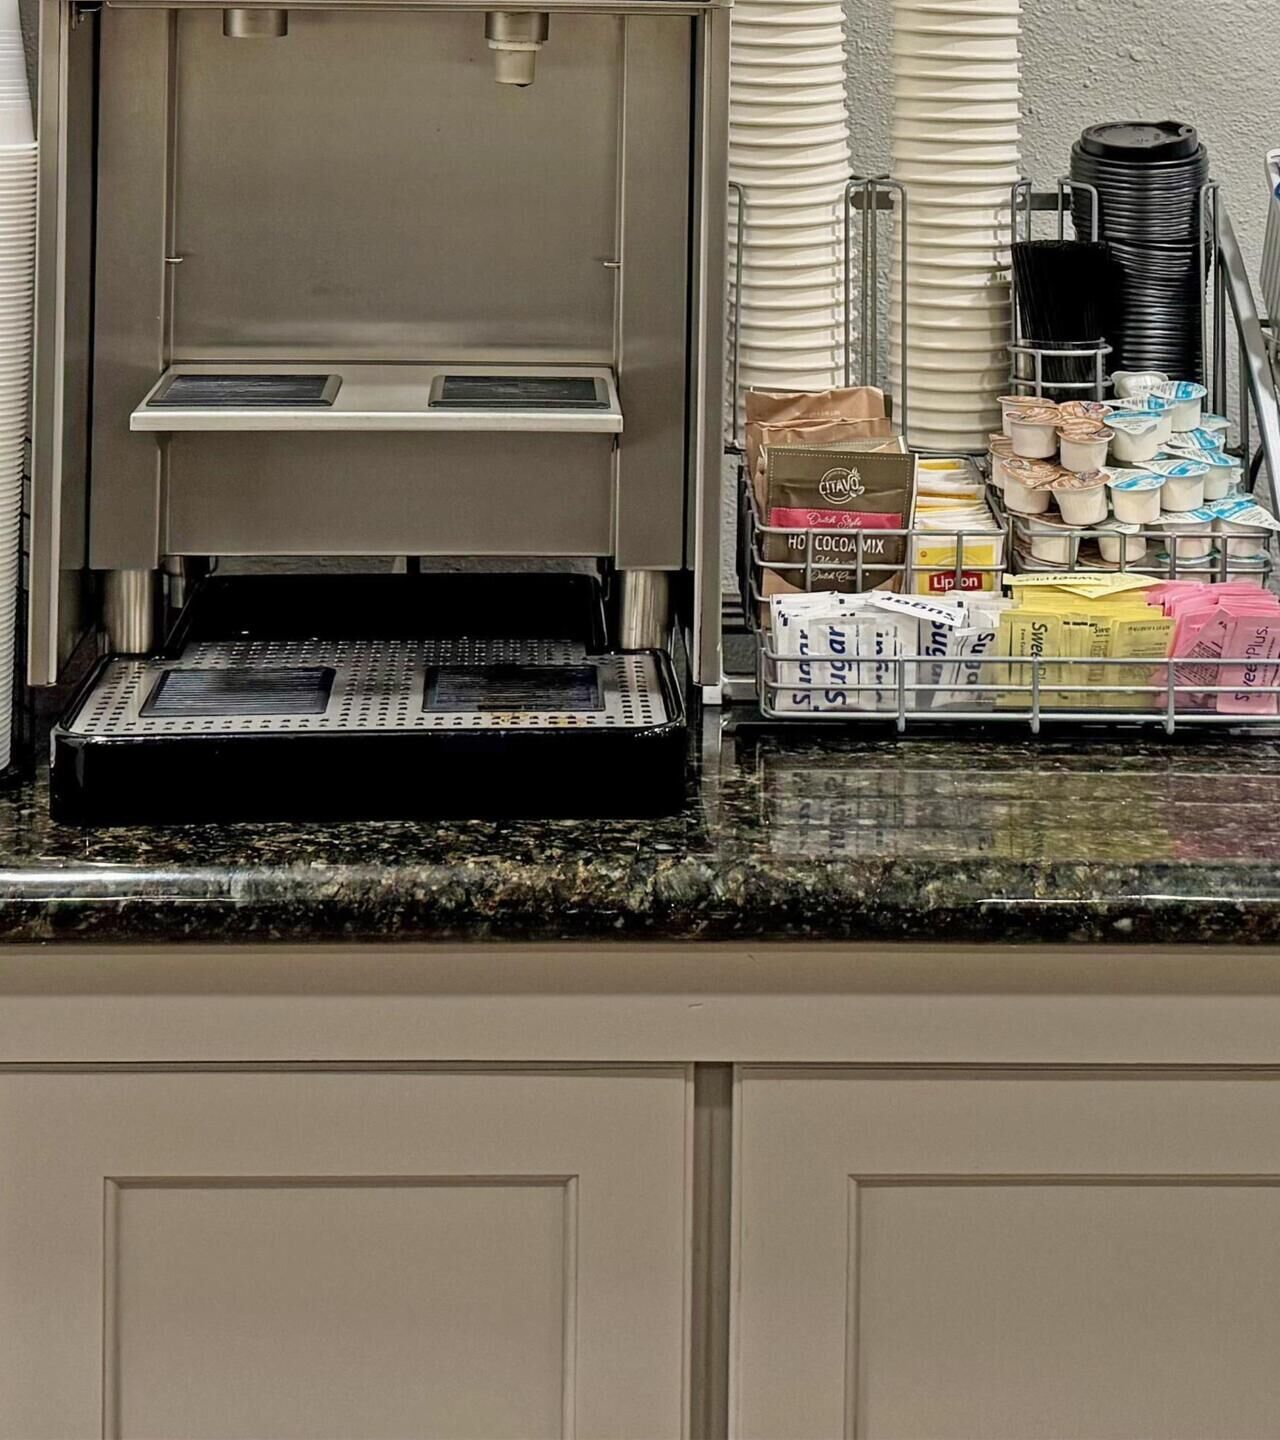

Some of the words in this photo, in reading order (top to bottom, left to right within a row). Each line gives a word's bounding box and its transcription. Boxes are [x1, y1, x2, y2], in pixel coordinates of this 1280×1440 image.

[819, 473, 859, 495] CITAVO
[837, 514, 863, 529] Style
[788, 535, 807, 550] HO
[815, 535, 857, 552] COCOA
[861, 539, 884, 554] MIX
[933, 577, 978, 590] Lipon
[881, 596, 956, 622] Sugar
